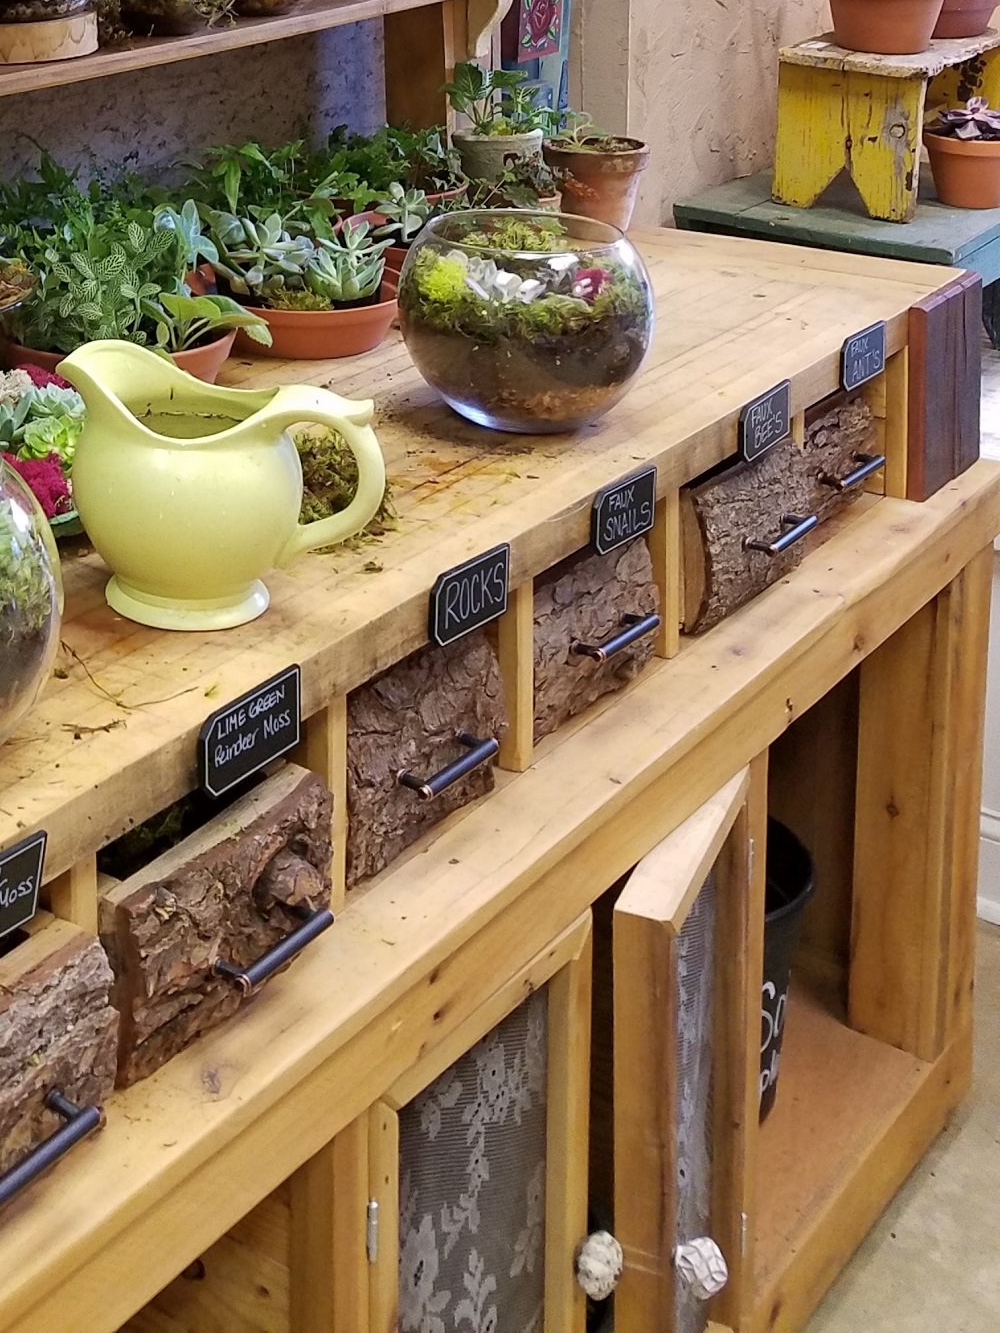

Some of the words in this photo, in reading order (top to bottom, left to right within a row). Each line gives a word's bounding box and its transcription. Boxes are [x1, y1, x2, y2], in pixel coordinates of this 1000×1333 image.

[751, 397, 774, 429] FAUX
[754, 410, 784, 449] BEE'S
[608, 485, 636, 513] FAUX
[603, 500, 652, 542] SNAILS
[444, 561, 505, 630] ROCKS
[216, 708, 247, 741] LIME
[247, 683, 286, 720] GREEN
[213, 727, 260, 768] Reindeer
[262, 708, 291, 740] Moss
